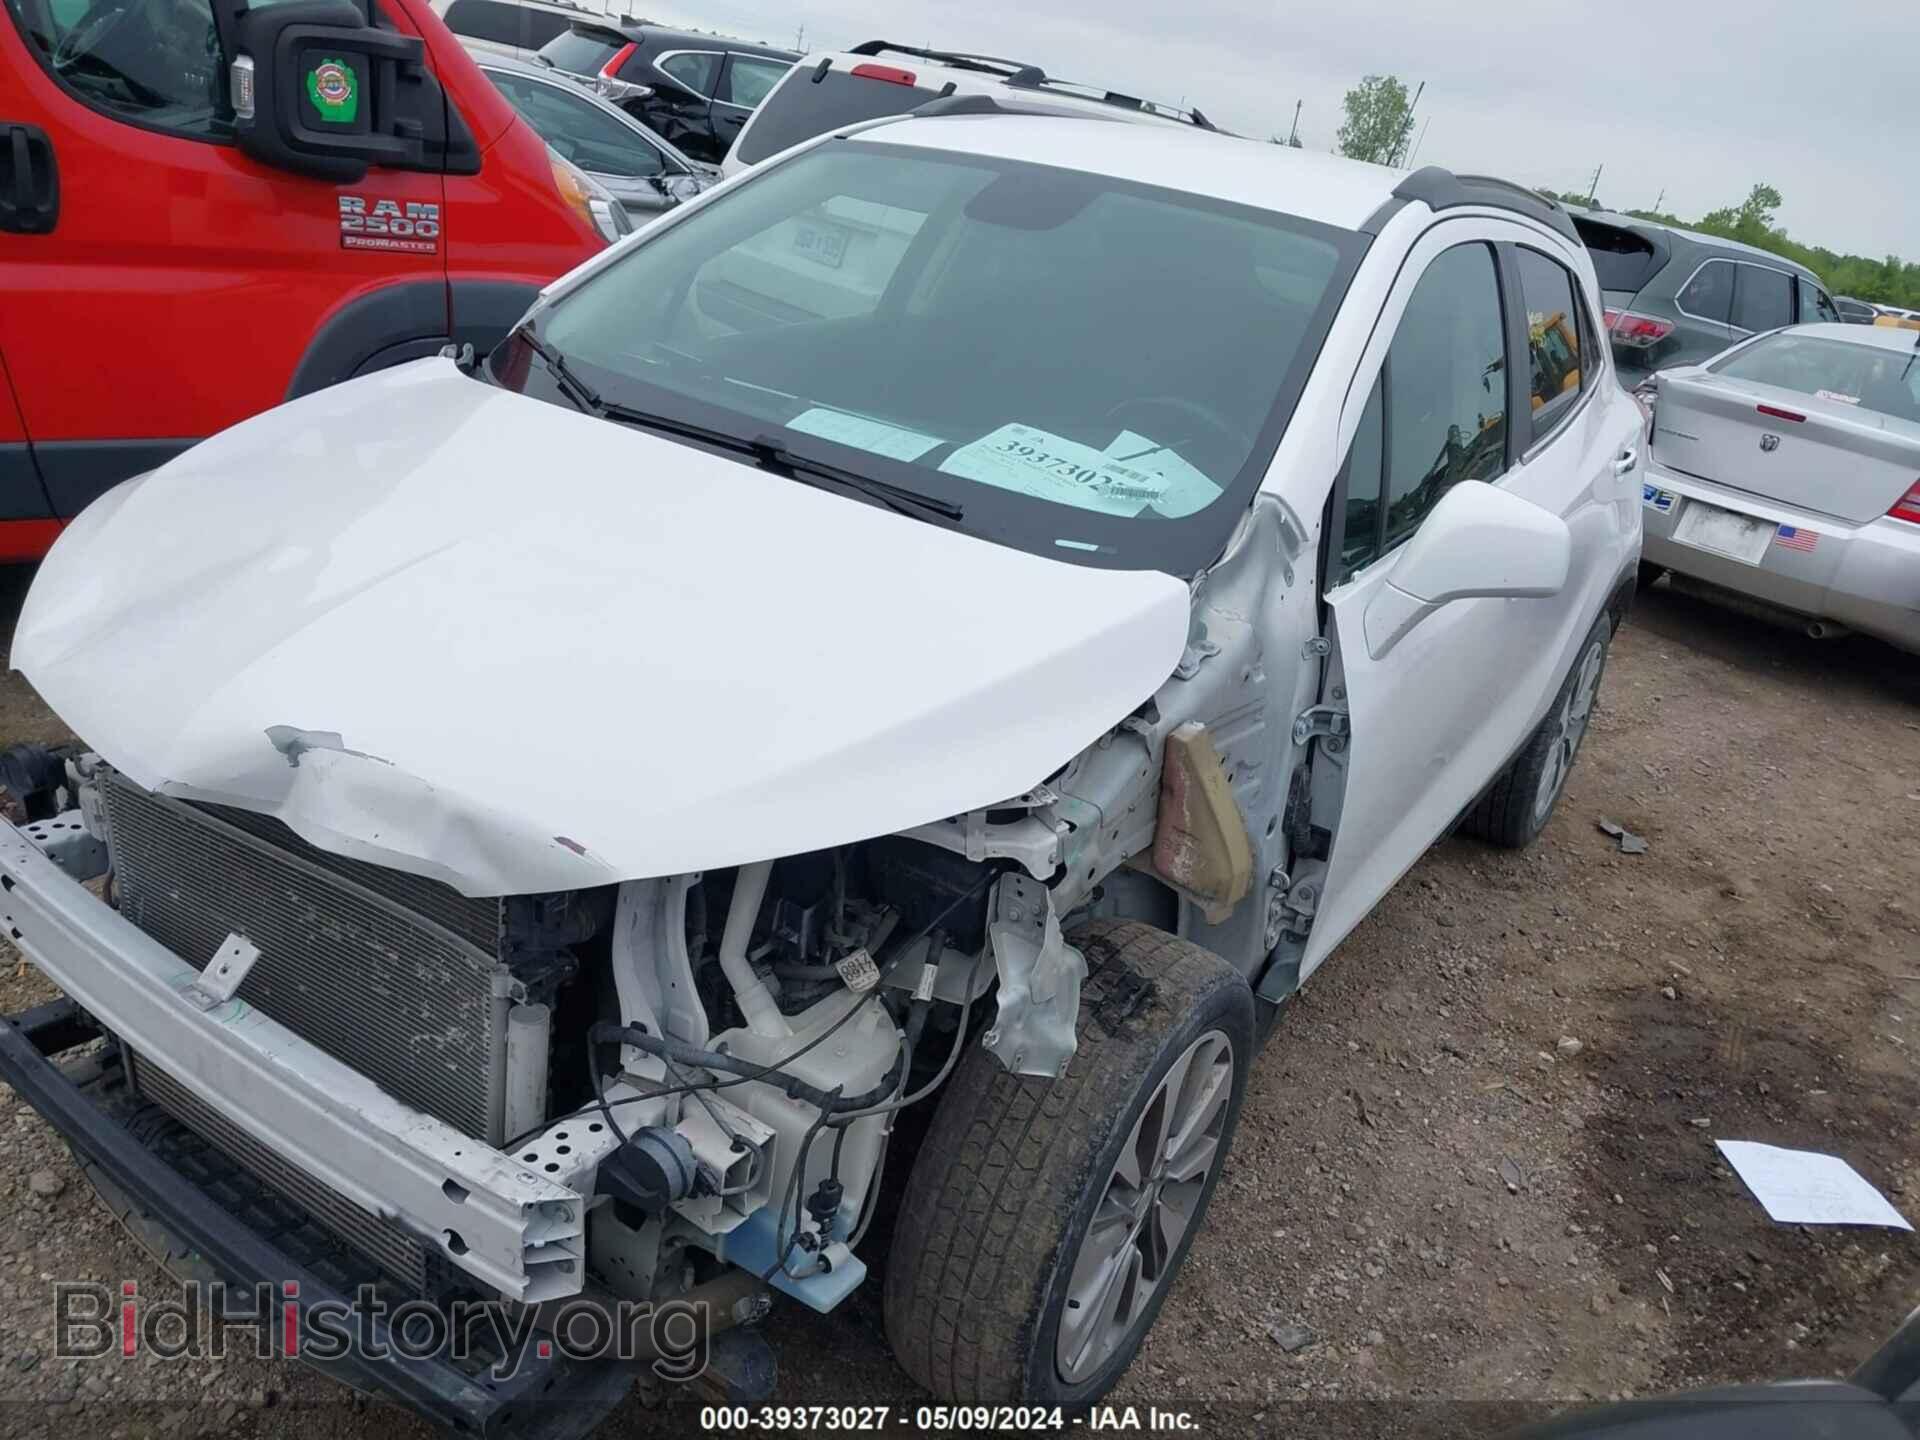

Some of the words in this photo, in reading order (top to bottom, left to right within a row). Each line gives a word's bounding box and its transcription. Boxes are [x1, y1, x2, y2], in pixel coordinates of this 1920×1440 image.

[339, 196, 439, 220] RAM
[341, 214, 439, 238] 2500
[995, 440, 1120, 492] 3937302
